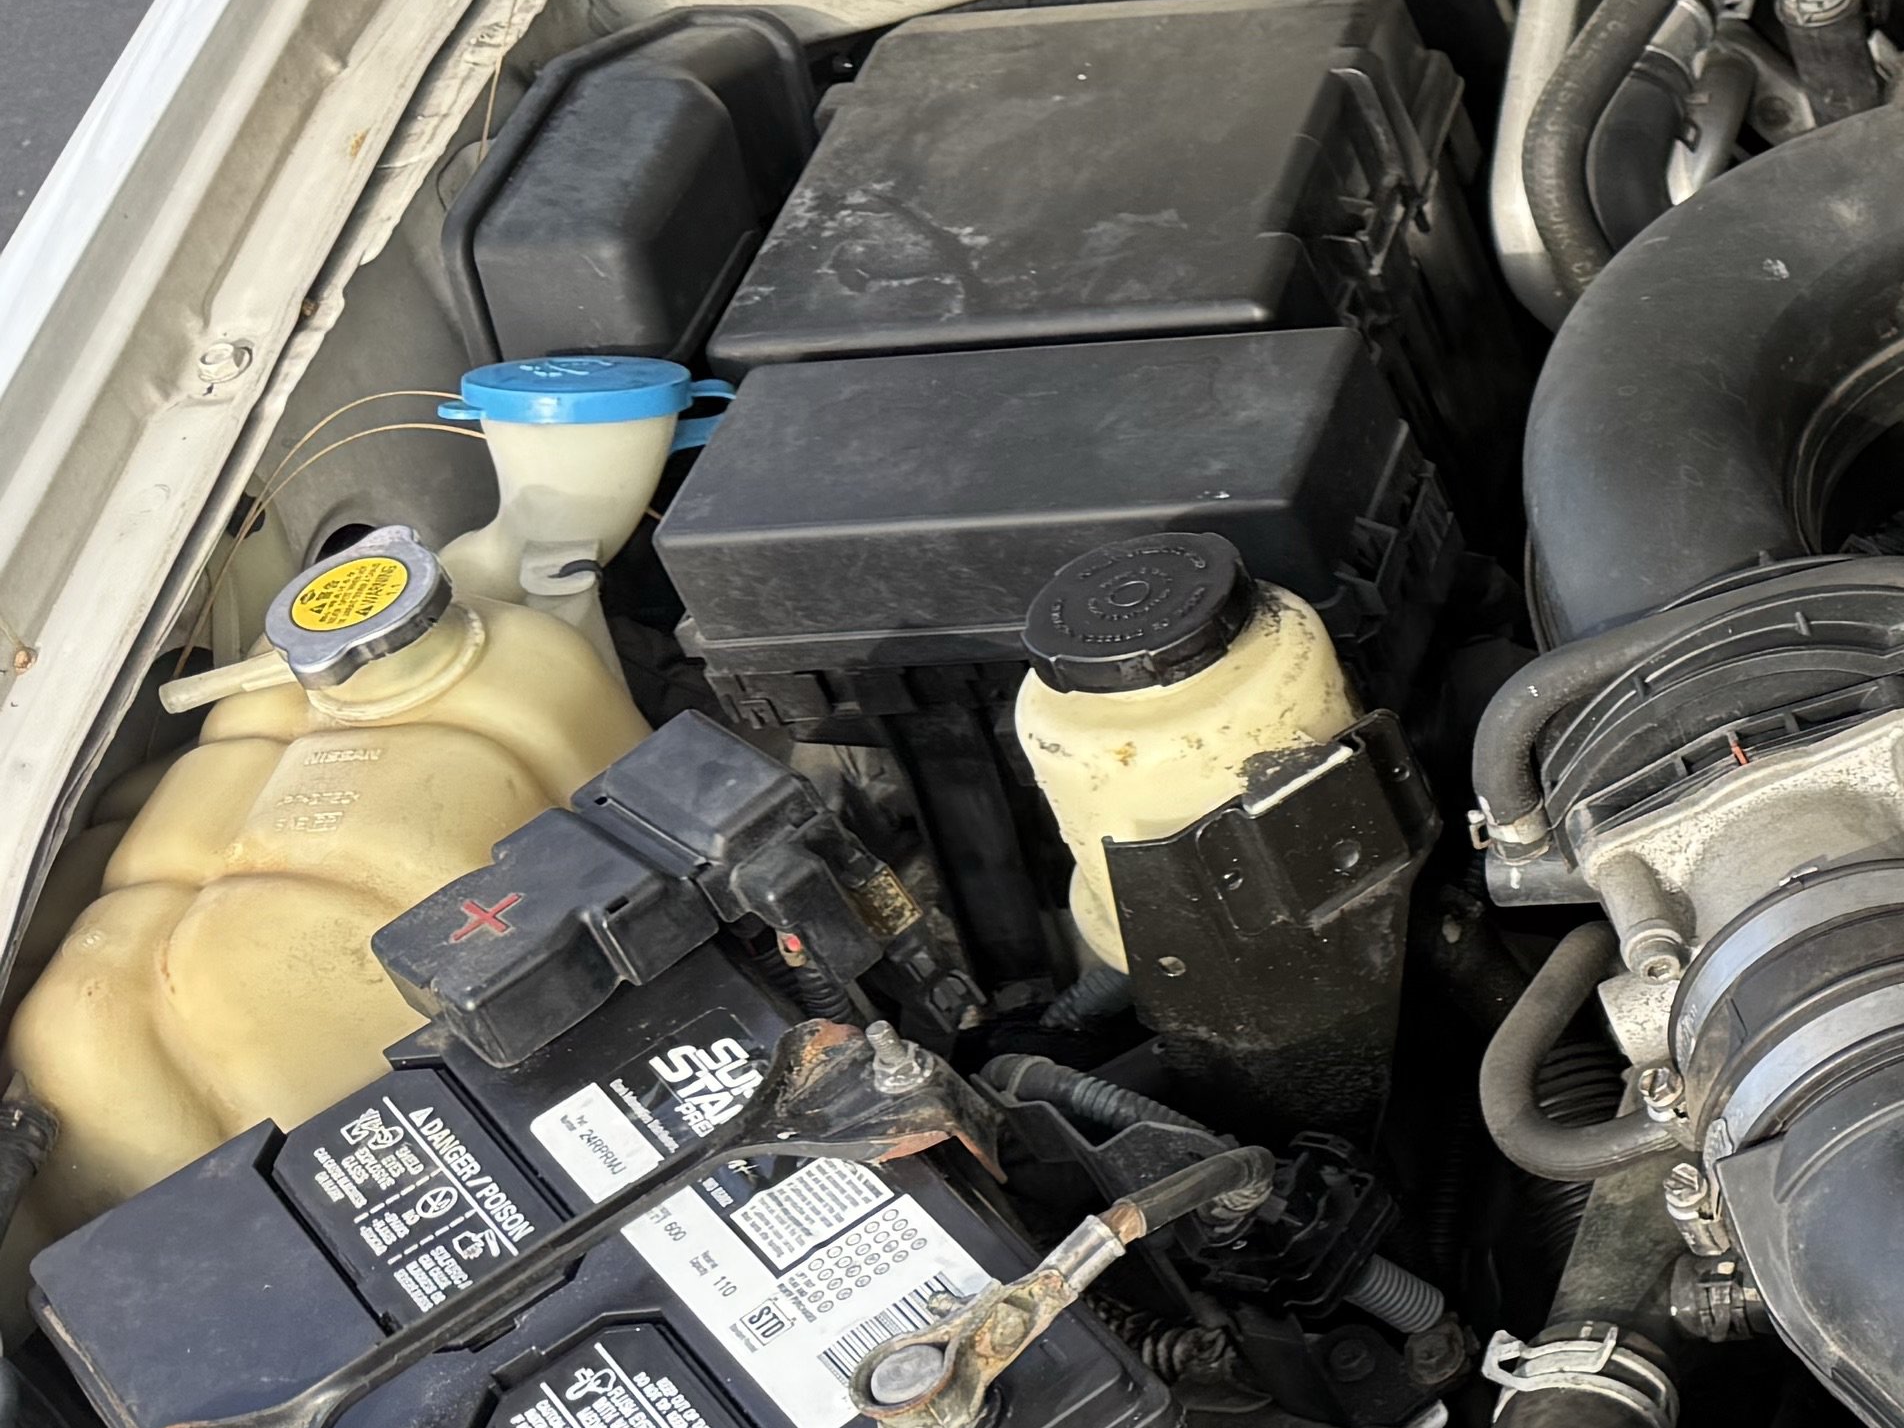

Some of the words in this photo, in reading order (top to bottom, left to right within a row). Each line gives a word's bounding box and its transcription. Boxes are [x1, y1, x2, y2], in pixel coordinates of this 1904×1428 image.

[673, 1099, 715, 1138] PRE
[664, 1221, 686, 1241] 600
[713, 1275, 736, 1296] 110
[748, 1306, 784, 1337] STD
